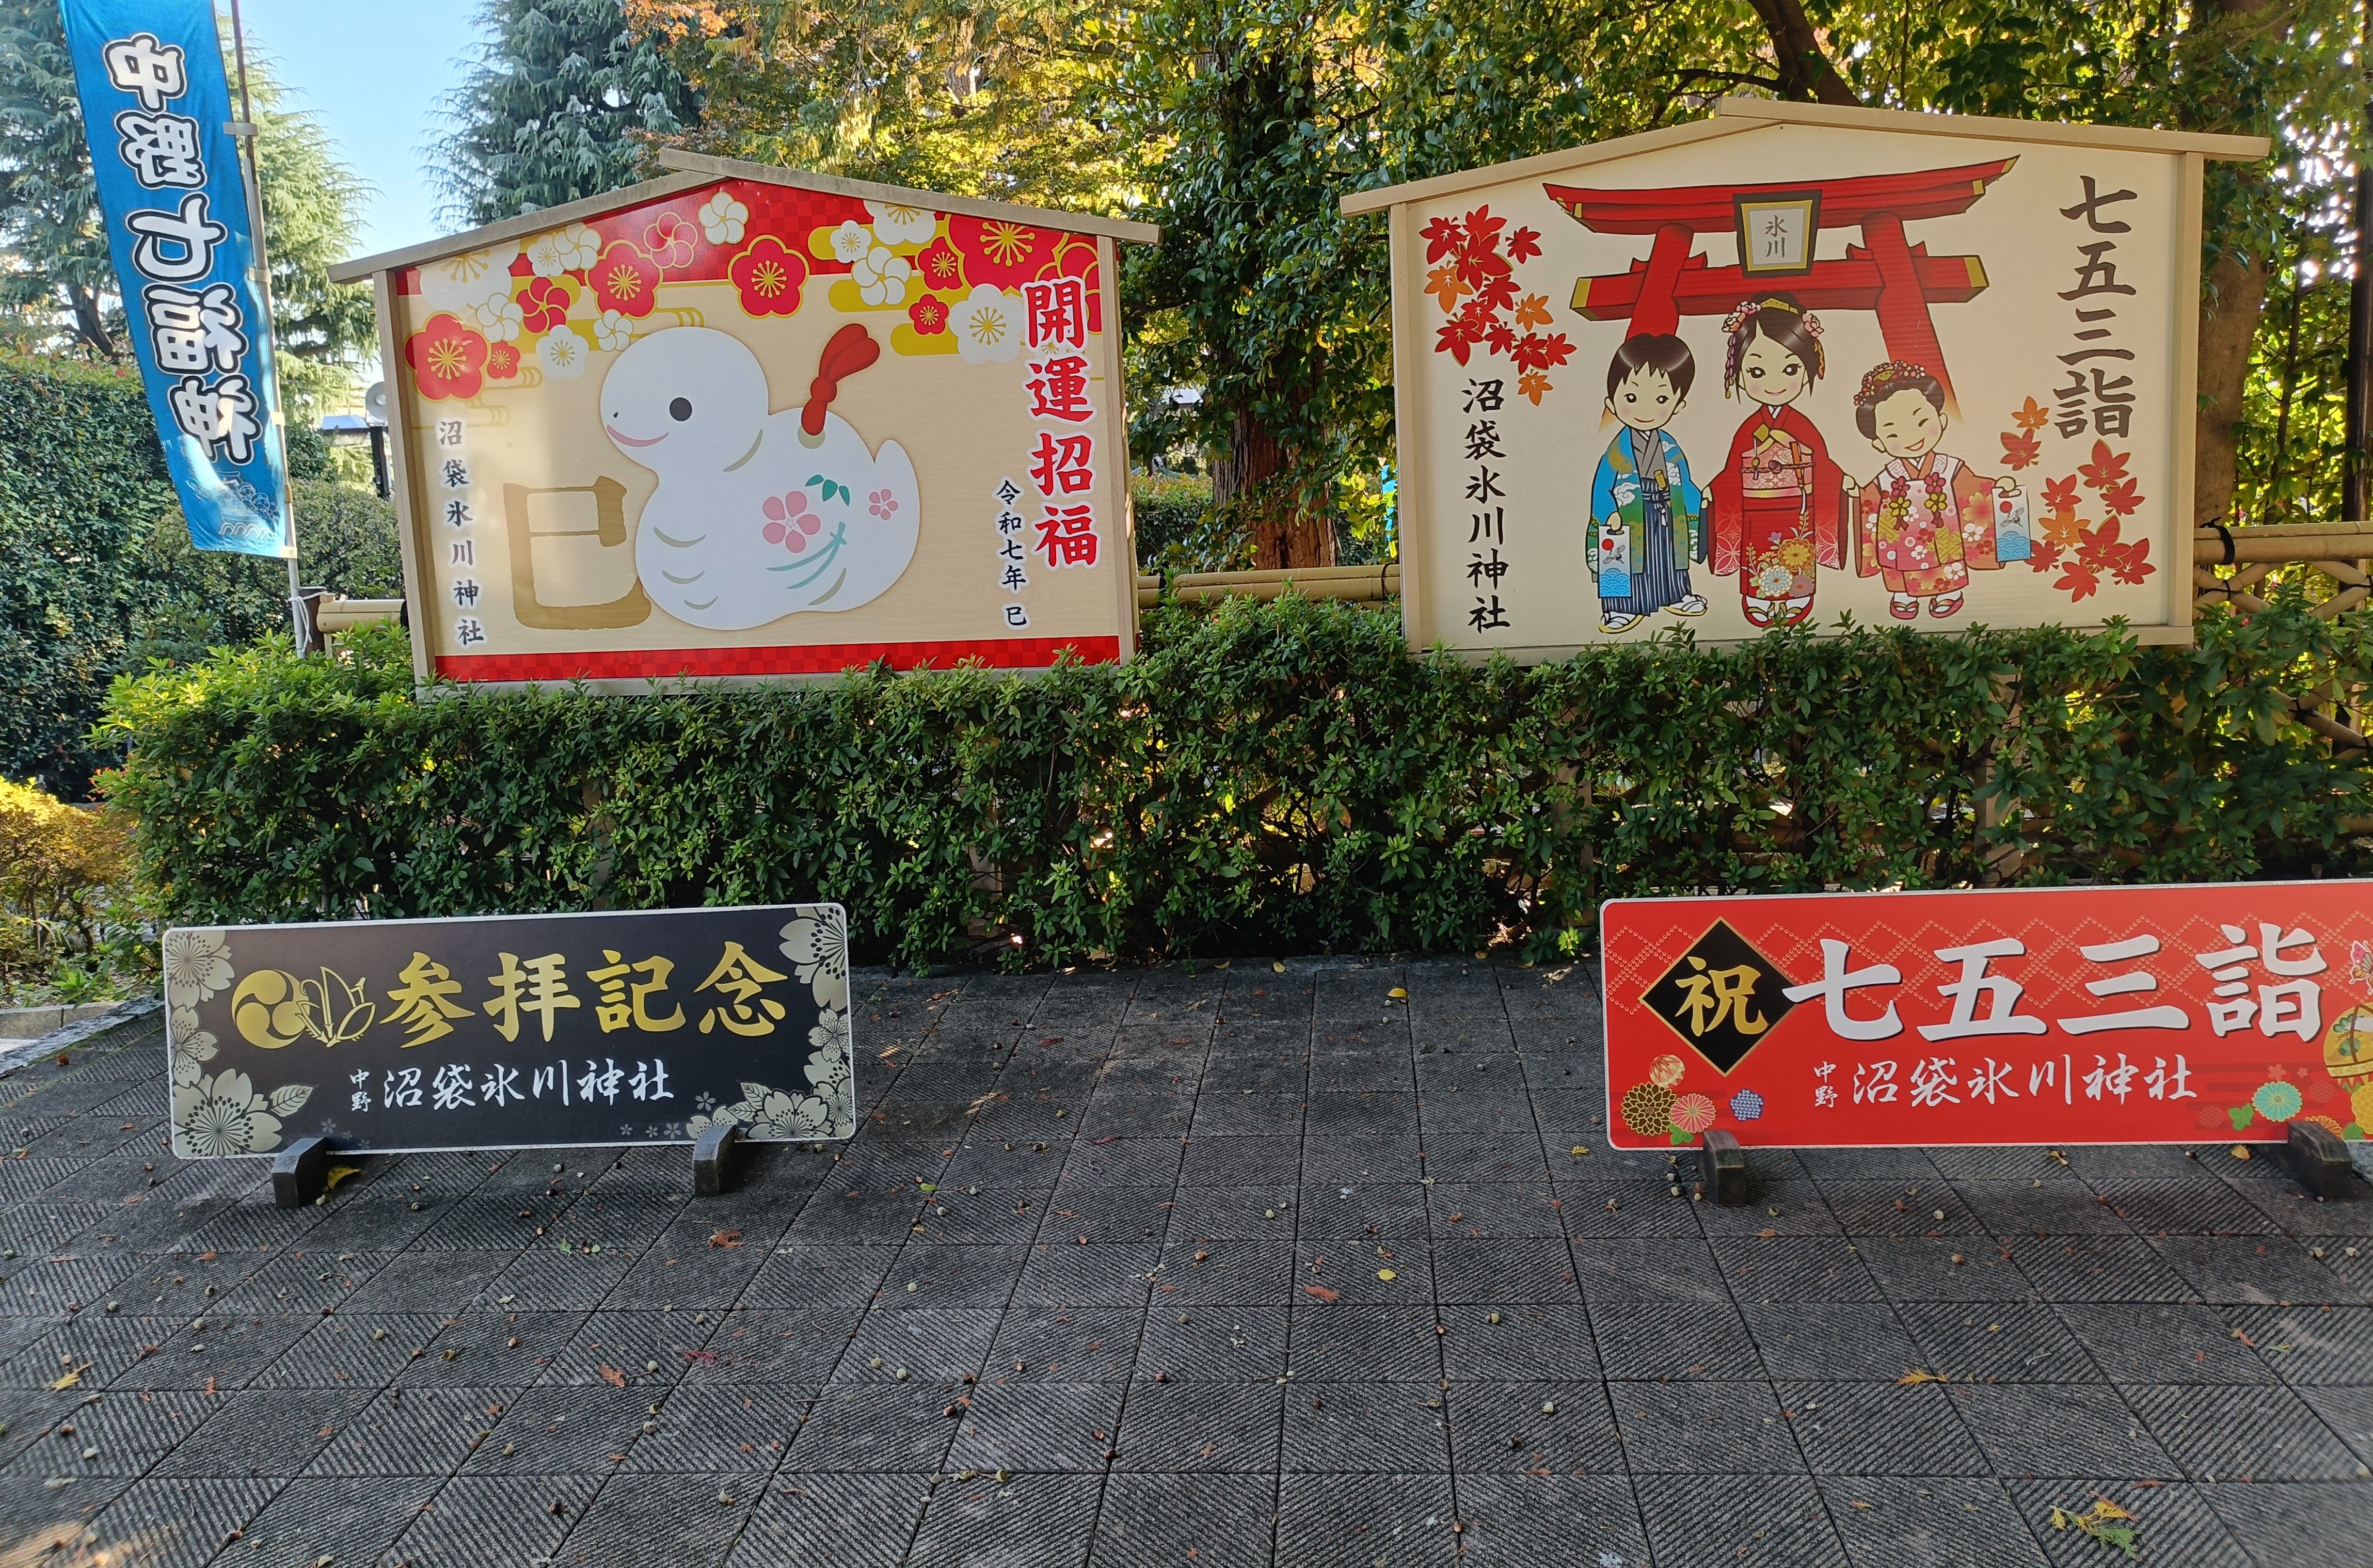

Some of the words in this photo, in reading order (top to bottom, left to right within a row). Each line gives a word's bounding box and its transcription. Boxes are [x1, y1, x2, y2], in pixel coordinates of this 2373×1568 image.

[1764, 215, 1789, 259] 氷川
[2052, 175, 2138, 439] 七五三詣
[1025, 280, 1098, 567] 開運招福
[436, 419, 485, 647] 沼袋氷川神社
[996, 480, 1026, 590] 令和七年
[1461, 378, 1511, 634] 沼袋氷川神社
[379, 941, 789, 1049] 参拝記念
[1674, 955, 1771, 1037] 祝
[1781, 922, 2328, 1042] 七五三詣
[349, 1068, 371, 1114] 中野
[383, 1058, 675, 1111] 沼袋氷川神社
[1814, 1061, 1836, 1109] 中野
[1852, 1052, 2197, 1107] 沼袋氷川神社
